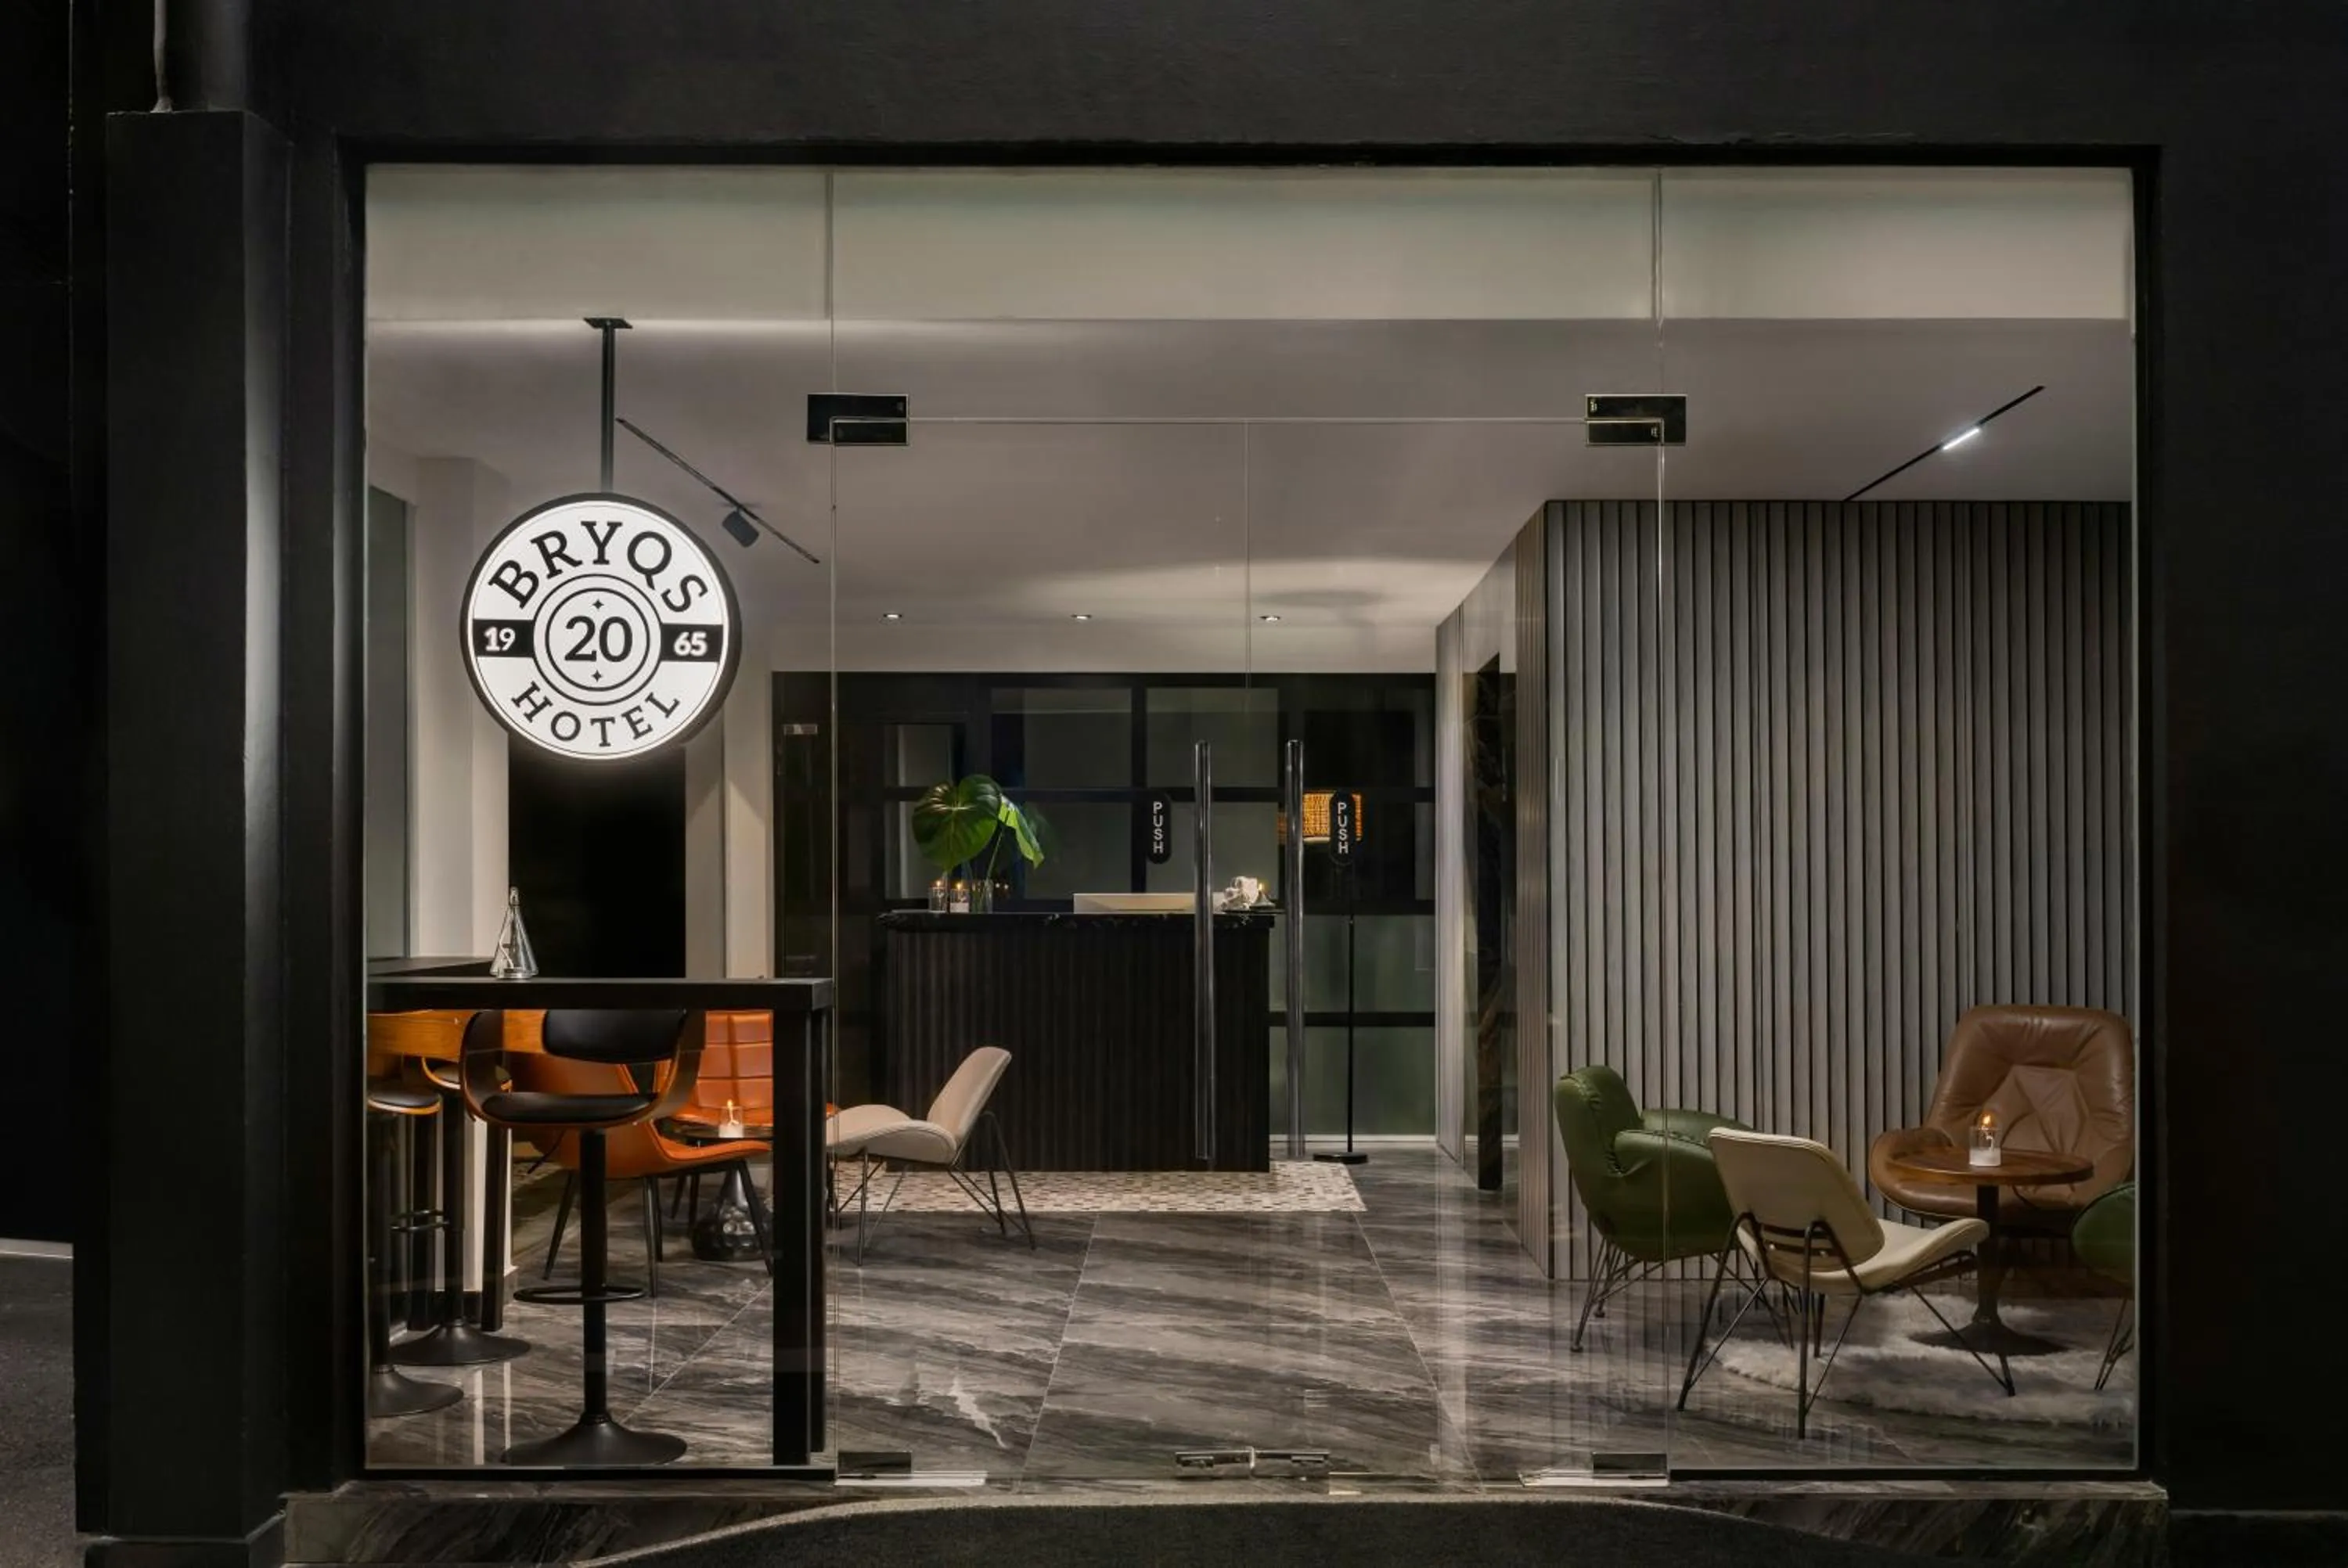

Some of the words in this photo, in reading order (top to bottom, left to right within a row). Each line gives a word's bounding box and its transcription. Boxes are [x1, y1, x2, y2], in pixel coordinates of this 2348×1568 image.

[488, 520, 708, 613] BRYQS
[483, 627, 517, 652] 19
[564, 615, 633, 663] 20
[674, 631, 708, 656] 65
[511, 682, 680, 747] HOTEL
[1153, 801, 1165, 854] PUSH
[1337, 802, 1349, 854] PUSH
